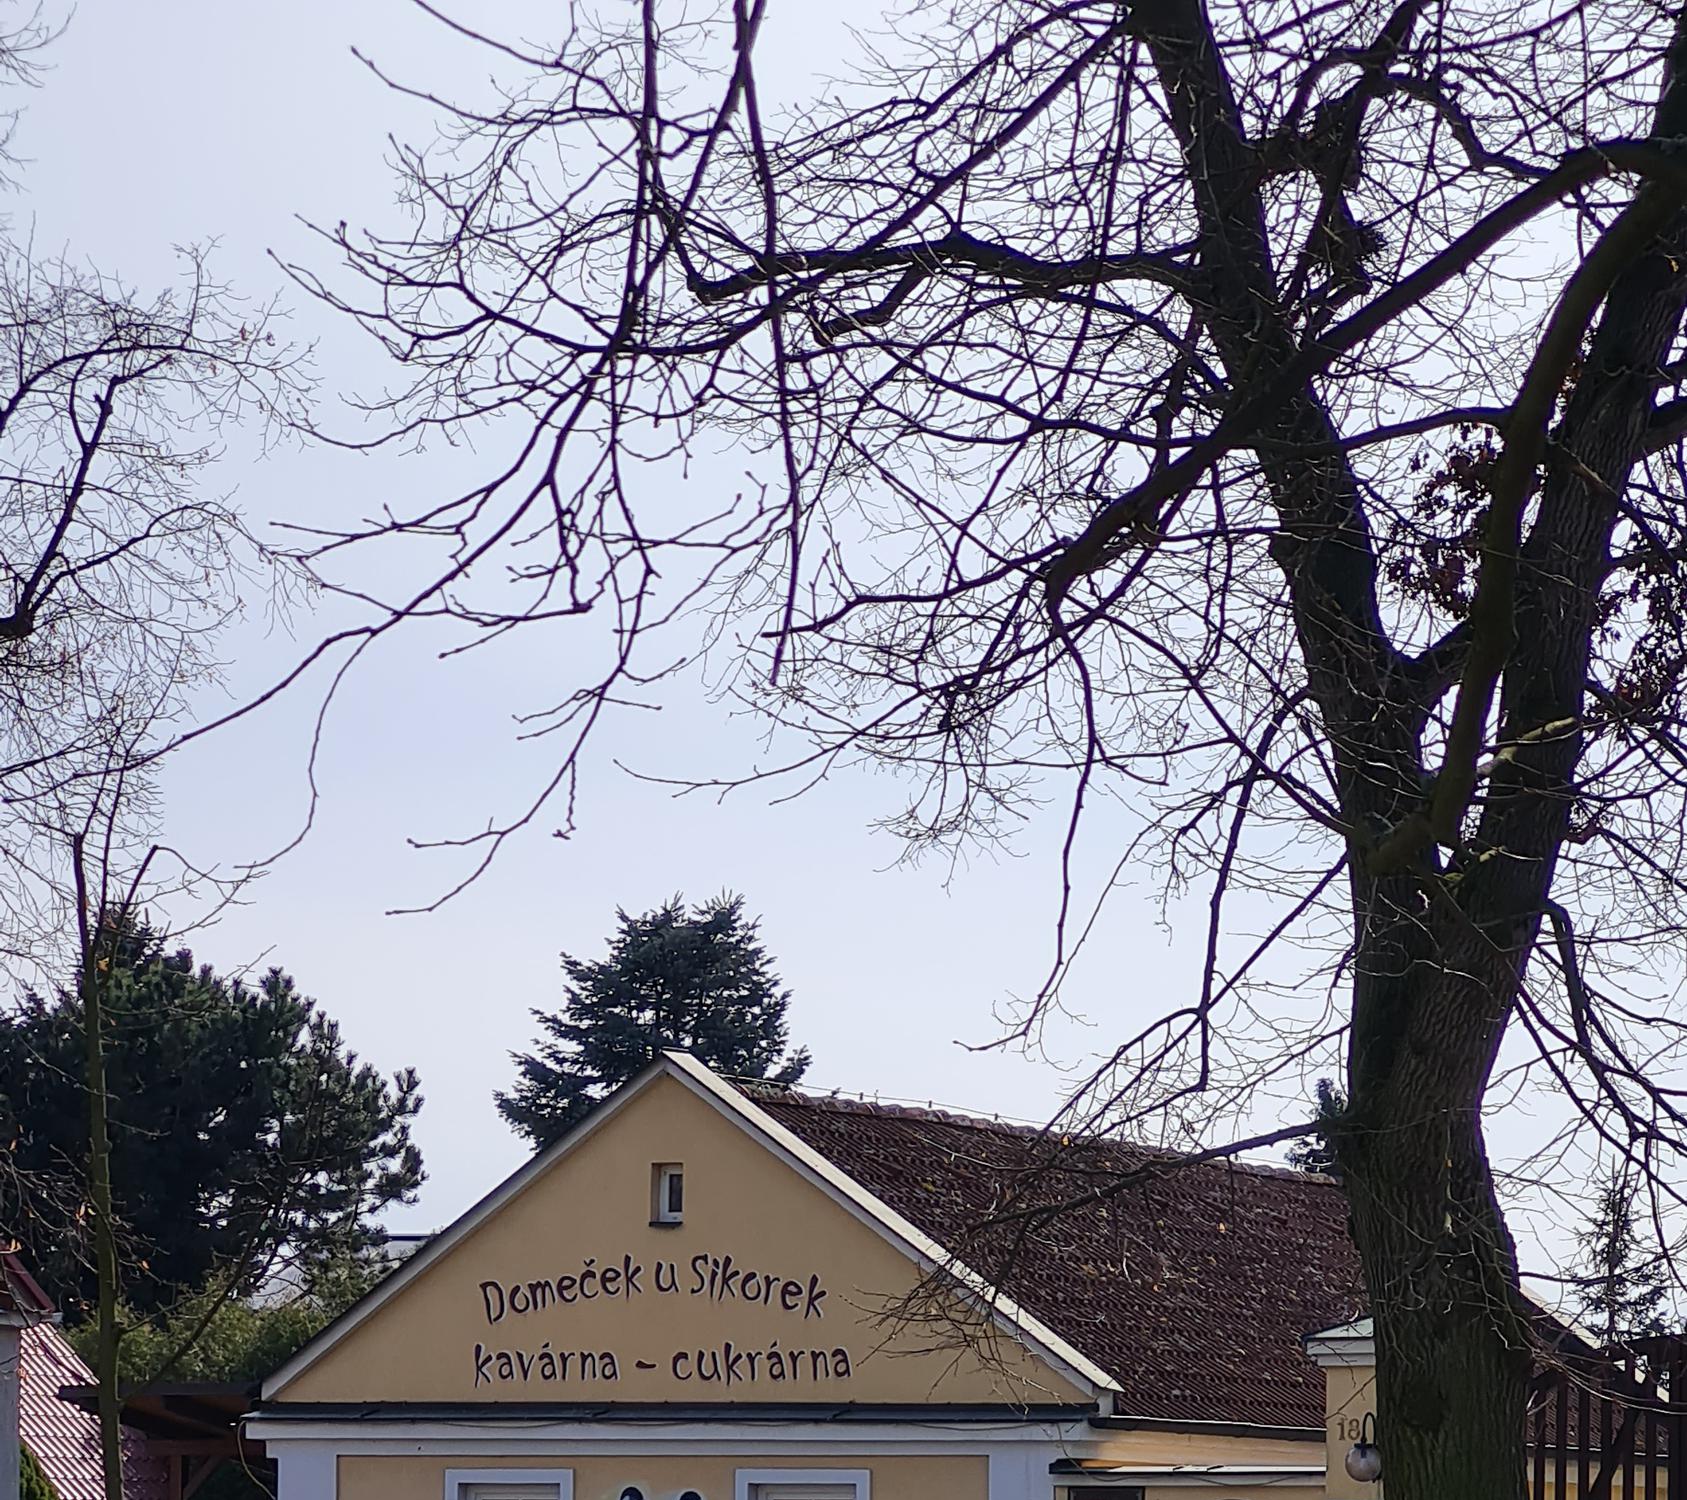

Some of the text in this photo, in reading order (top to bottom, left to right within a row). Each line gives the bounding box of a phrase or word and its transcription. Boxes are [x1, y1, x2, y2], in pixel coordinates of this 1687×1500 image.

[479, 1254, 643, 1324] Domeček
[690, 1253, 828, 1320] Sikorek
[474, 1341, 620, 1388] kavárna
[671, 1340, 852, 1388] cukrárna
